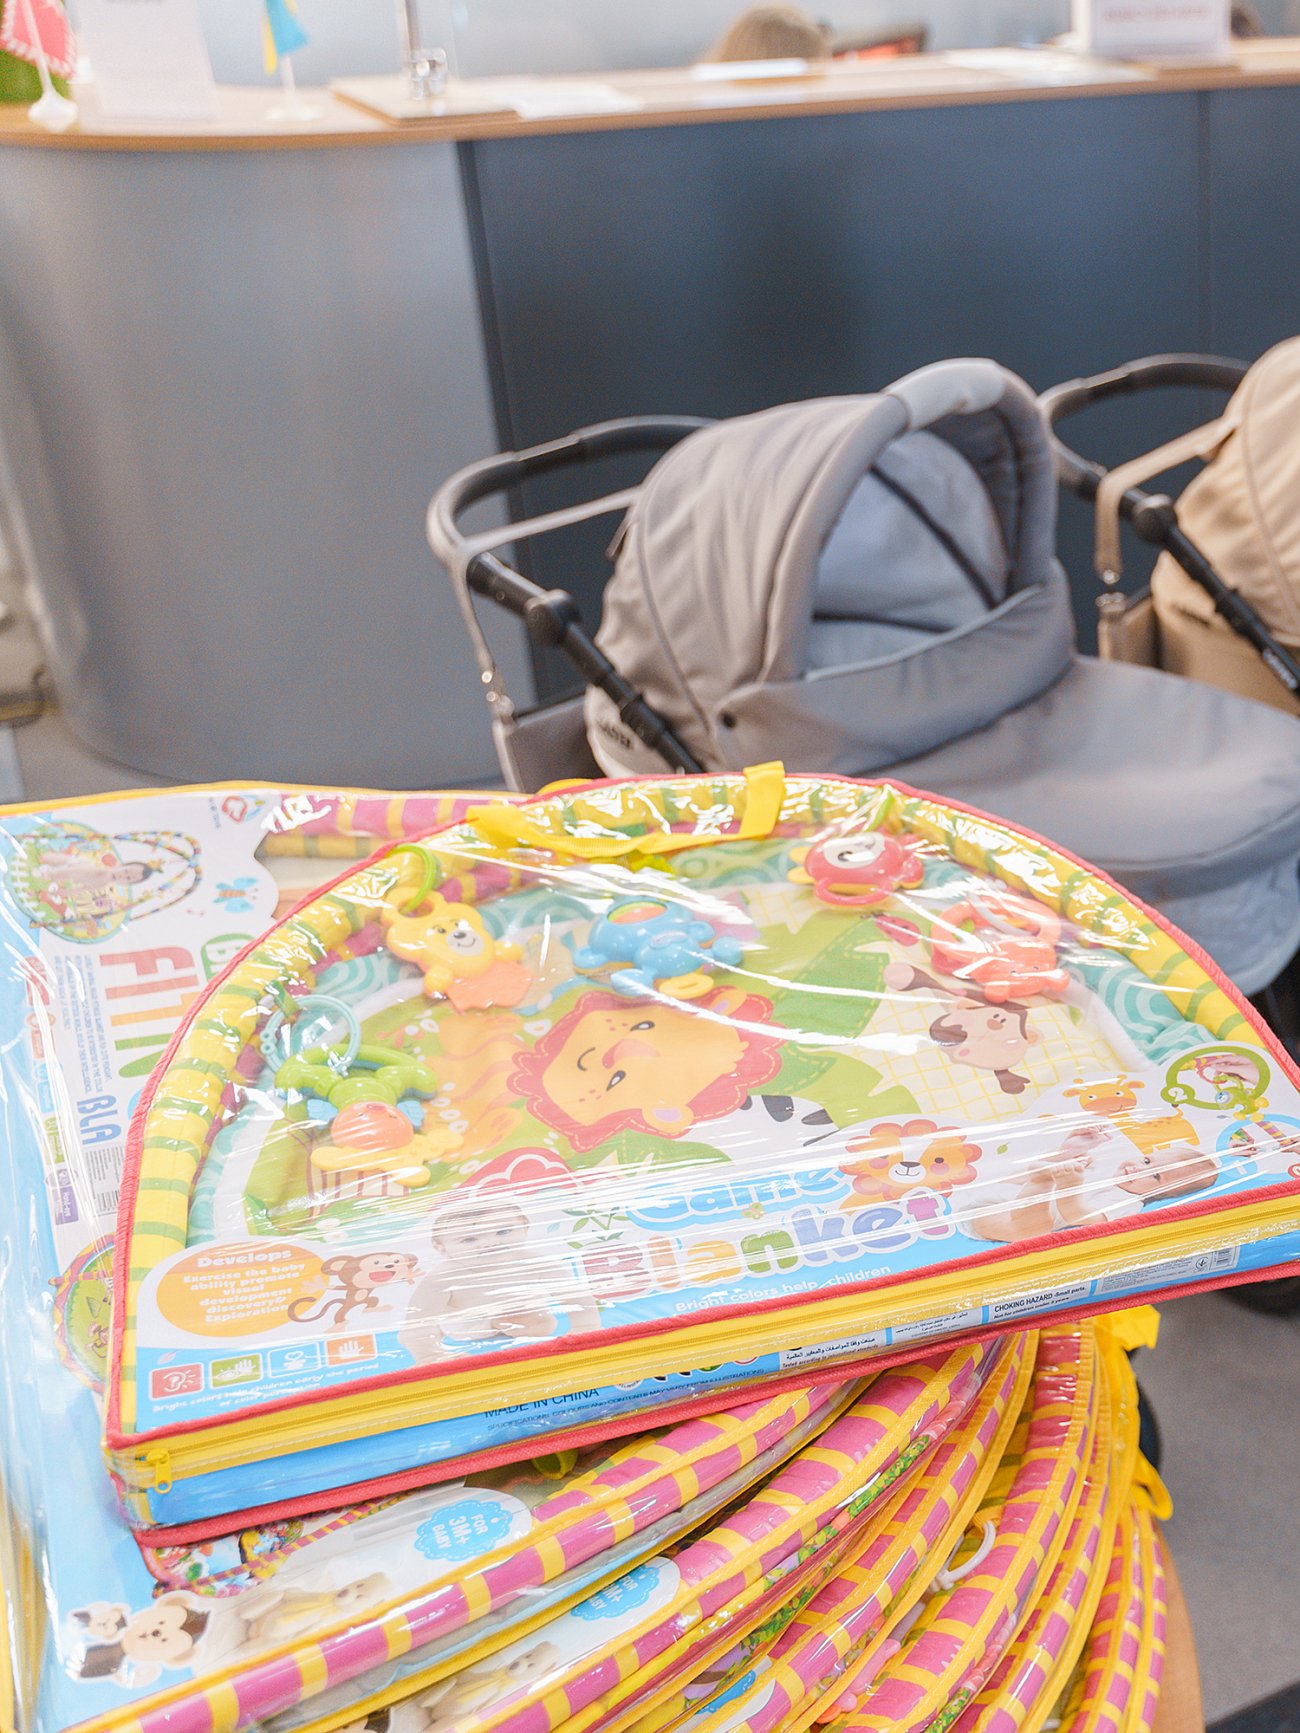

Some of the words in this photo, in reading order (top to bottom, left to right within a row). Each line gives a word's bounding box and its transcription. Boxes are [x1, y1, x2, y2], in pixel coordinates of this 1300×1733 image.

[77, 1095, 122, 1146] BLA
[580, 1187, 955, 1301] Blanket
[197, 1249, 292, 1268] Develops
[245, 1269, 267, 1277] the
[271, 1263, 305, 1274] baby
[190, 1280, 236, 1291] ability
[240, 1272, 300, 1287] promote
[223, 1284, 265, 1296] visual
[675, 1294, 725, 1313] Bright
[730, 1286, 779, 1302] colors
[782, 1280, 818, 1295] help
[828, 1265, 892, 1286] children
[199, 1288, 293, 1307] development
[994, 1300, 1025, 1313] CHOKING
[1025, 1293, 1053, 1305] HAZARD
[204, 1304, 289, 1323] Exploration
[484, 1403, 529, 1418] MADE
[533, 1399, 549, 1409] IN
[552, 1388, 600, 1405] CHINA
[448, 1515, 473, 1546] 3M+
[471, 1513, 489, 1535] FOR
[432, 1523, 452, 1549] BABY
